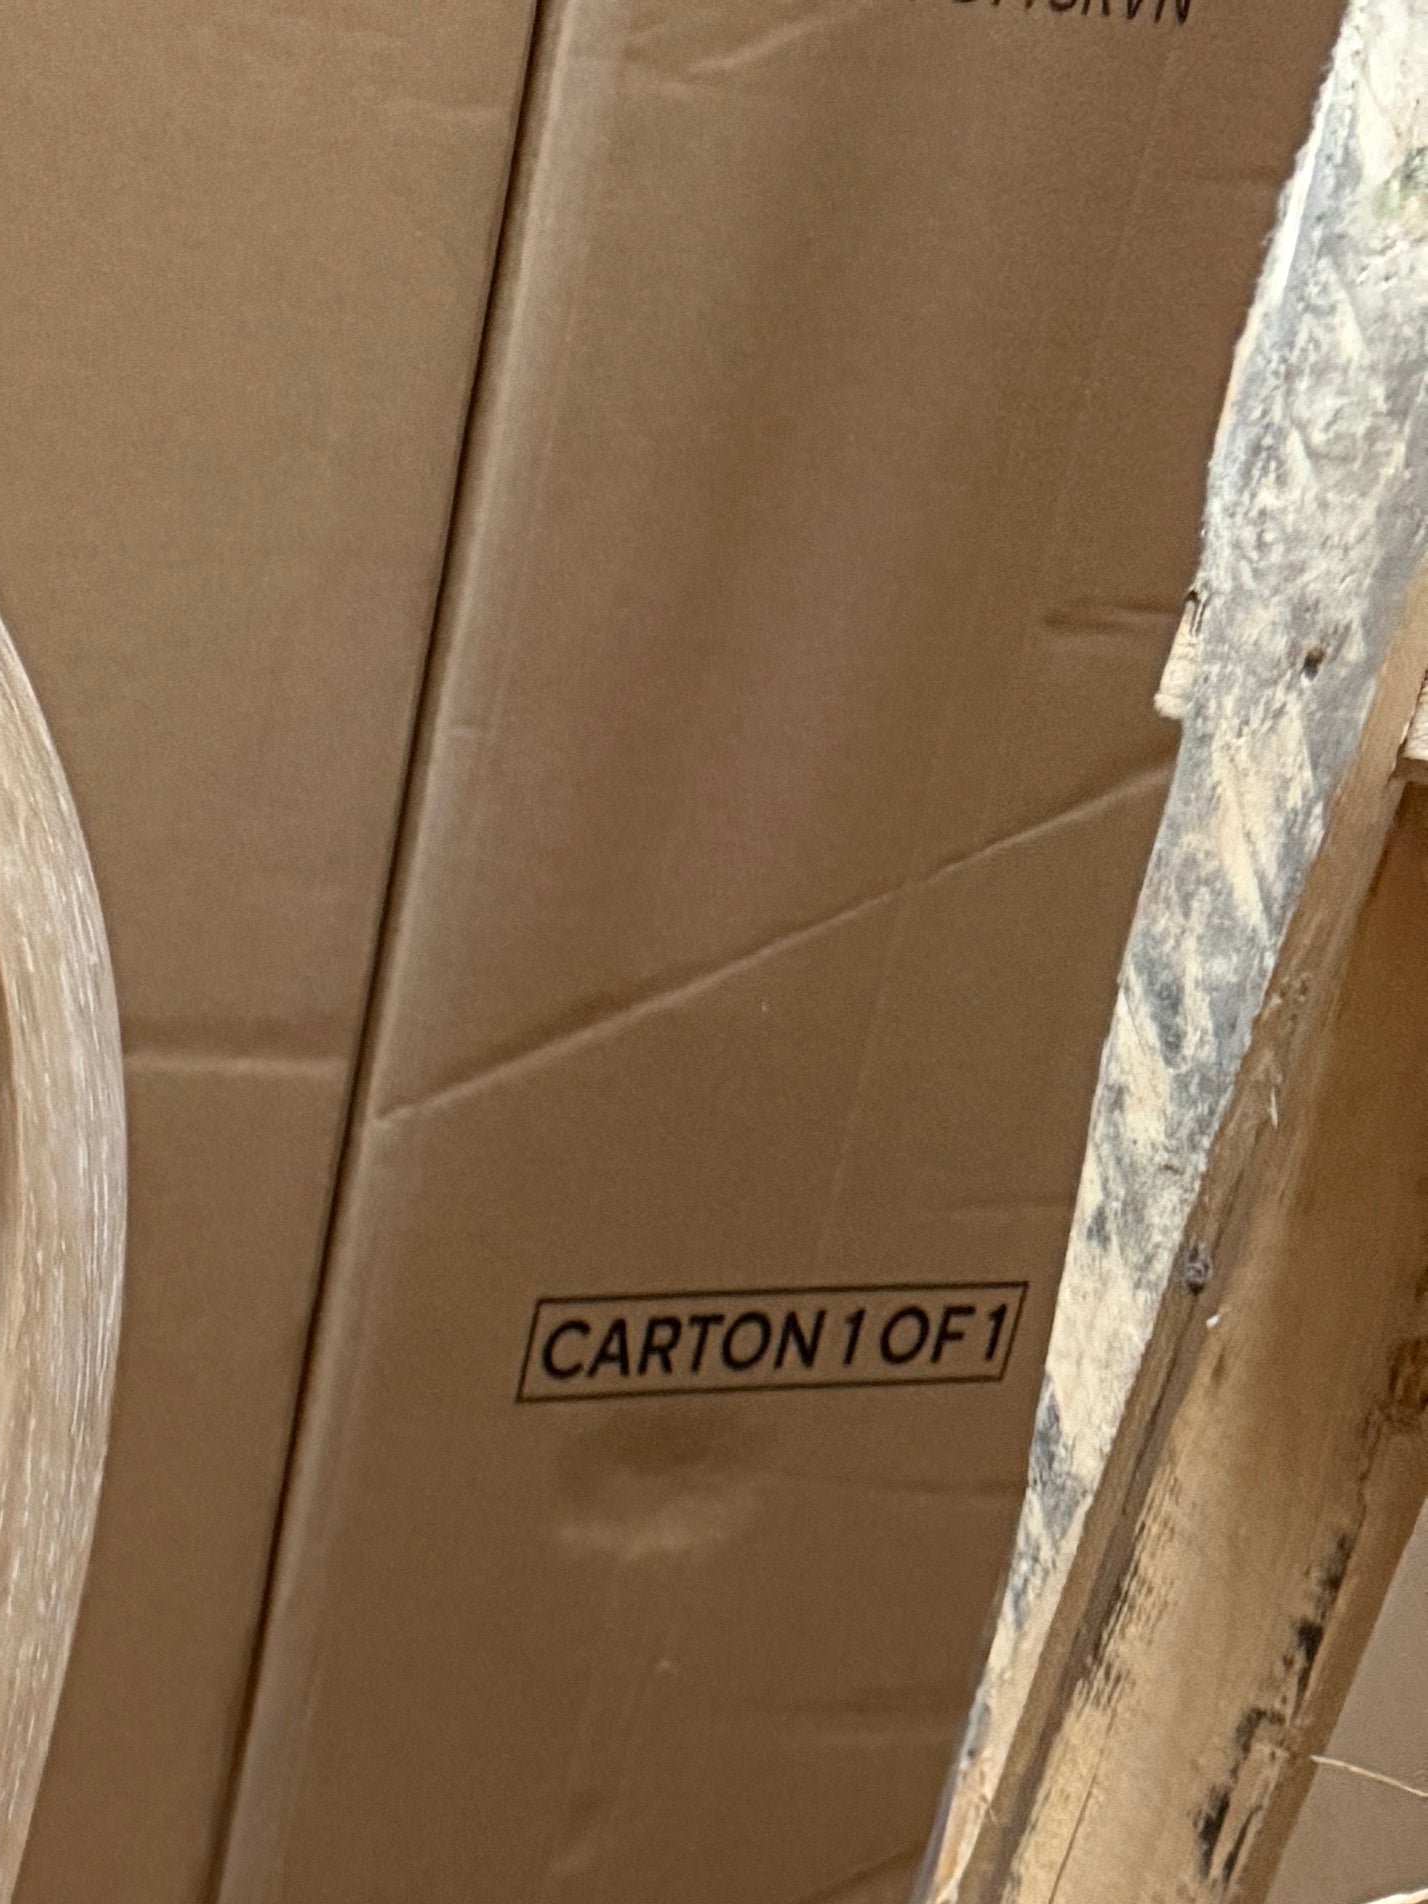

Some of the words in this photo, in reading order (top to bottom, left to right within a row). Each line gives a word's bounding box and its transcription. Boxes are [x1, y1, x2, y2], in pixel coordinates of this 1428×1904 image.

[543, 1307, 827, 1380] CARTON
[843, 1308, 866, 1367] 1
[879, 1304, 976, 1366] OF
[985, 1303, 1009, 1362] 1
